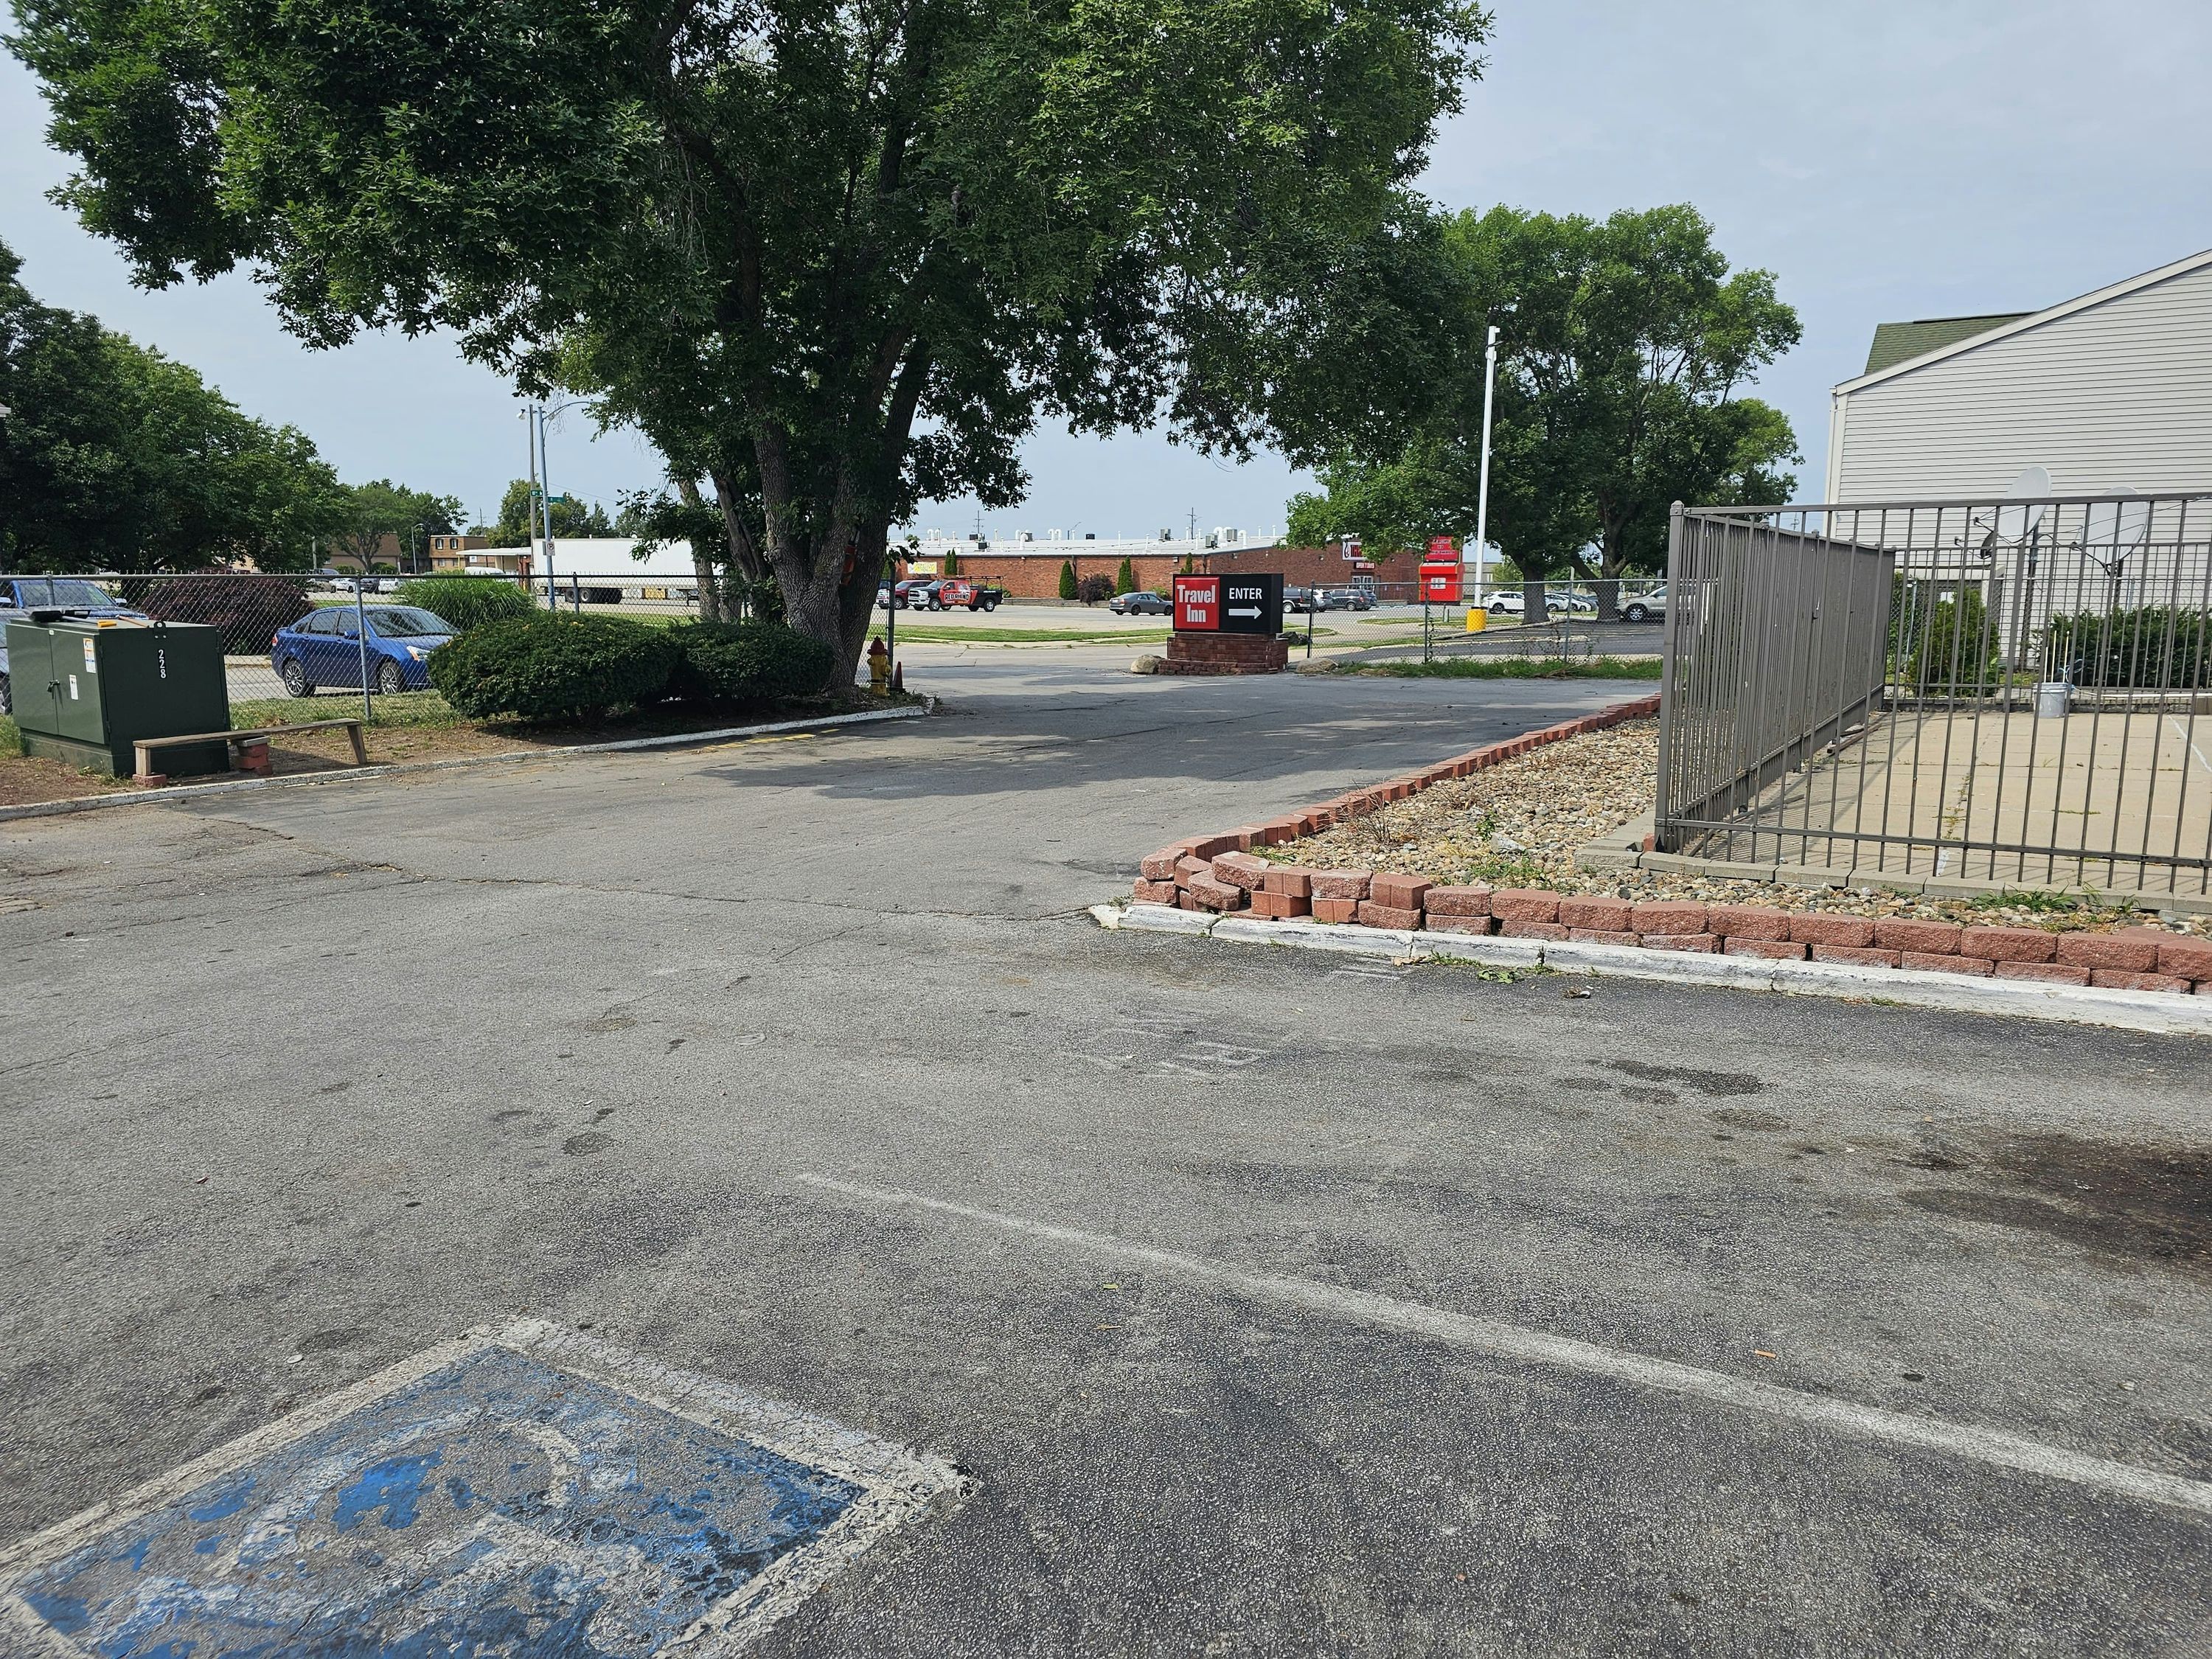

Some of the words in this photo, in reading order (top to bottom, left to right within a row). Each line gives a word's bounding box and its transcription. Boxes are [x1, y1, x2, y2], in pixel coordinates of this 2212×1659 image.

[1177, 585, 1216, 603] Travel
[1228, 588, 1262, 599] ENTER
[1186, 604, 1206, 622] Inn
[158, 649, 167, 678] 228
